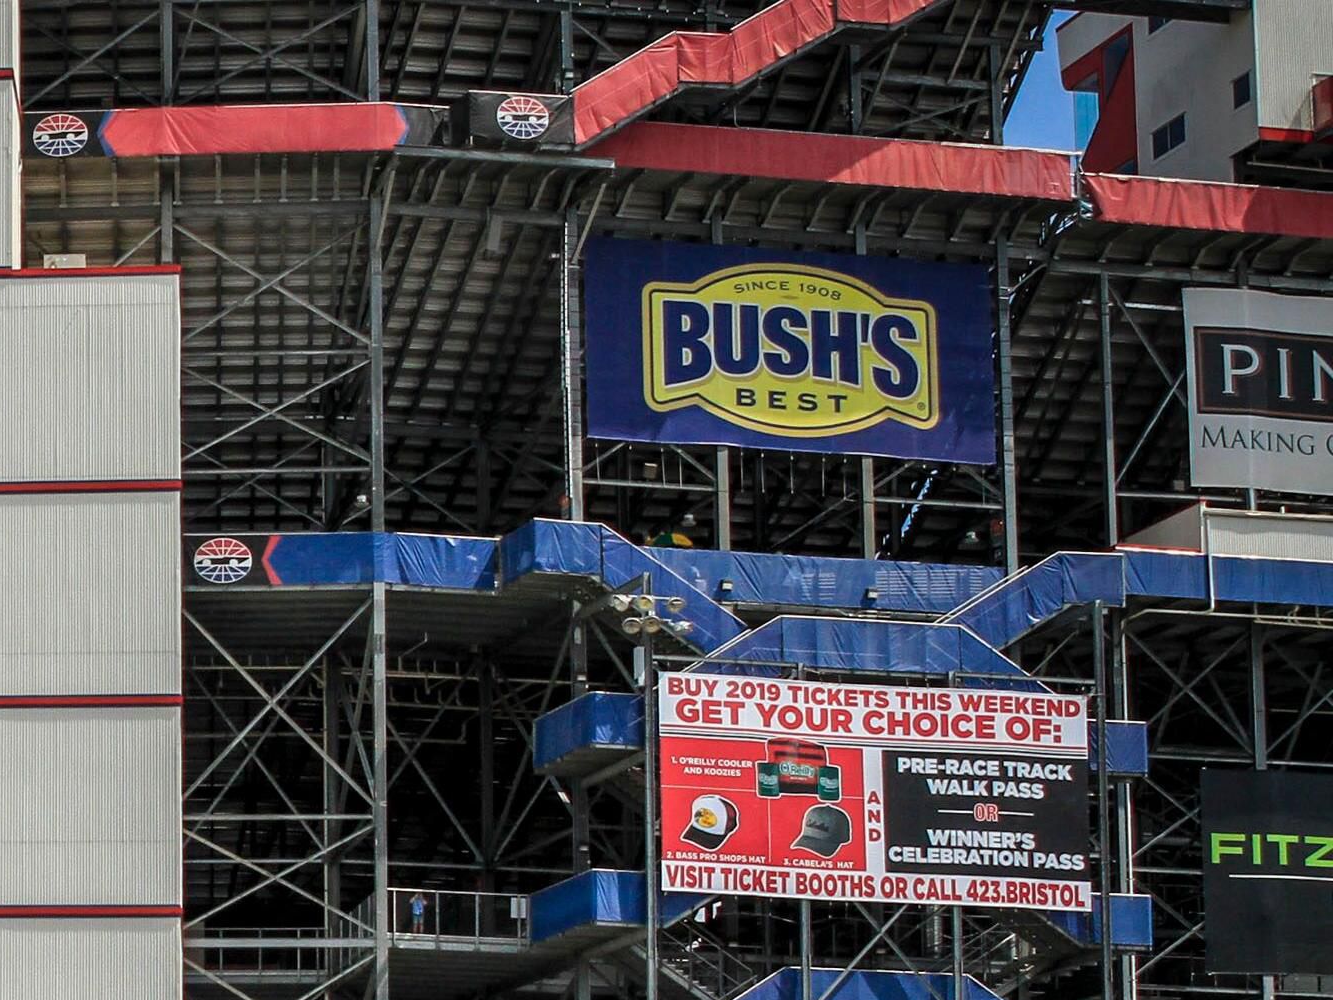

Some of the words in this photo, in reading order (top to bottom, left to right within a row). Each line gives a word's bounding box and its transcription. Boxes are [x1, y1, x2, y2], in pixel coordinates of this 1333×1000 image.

[734, 280, 790, 293] SINCE
[799, 284, 842, 300] 1908
[663, 300, 920, 399] BUSH'S
[736, 388, 848, 414] BEST
[1202, 425, 1315, 456] MAKING
[667, 678, 719, 697] BUY
[725, 681, 781, 702] 2019
[788, 686, 889, 708] TICKETS
[896, 692, 952, 711] THIS
[958, 694, 1081, 717] WEEKEND
[675, 698, 745, 725] GET
[756, 703, 853, 733] YOUR
[862, 710, 996, 739] CHOICE
[1005, 716, 1061, 743] OF:
[679, 757, 716, 766] O'REILLY
[717, 759, 753, 768] COOLER
[684, 766, 702, 775] AND
[704, 767, 741, 777] KOOZIES
[897, 757, 1000, 776] PRE-RACE
[1003, 761, 1073, 780] TRACK
[927, 779, 988, 797] WALK
[993, 781, 1045, 799] PASS
[867, 791, 882, 842] AND
[973, 803, 999, 822] OR
[927, 829, 1035, 850] WINNER'S
[1211, 833, 1333, 867] FITZ
[676, 852, 697, 860] BASS
[700, 853, 717, 861] PRO
[719, 854, 747, 863] SHOPS
[749, 855, 765, 863] HAT
[792, 859, 833, 868] CABELA'S
[837, 861, 854, 869] HAT
[888, 846, 1029, 867] CELEBRATION
[1033, 852, 1085, 871] PASS
[665, 865, 716, 888] VISIT
[720, 868, 790, 893] TICKET
[795, 872, 876, 897] BOOTHS
[880, 878, 908, 899] OR
[913, 878, 962, 901] CALL
[966, 880, 1086, 907] 423.BRISTOL
